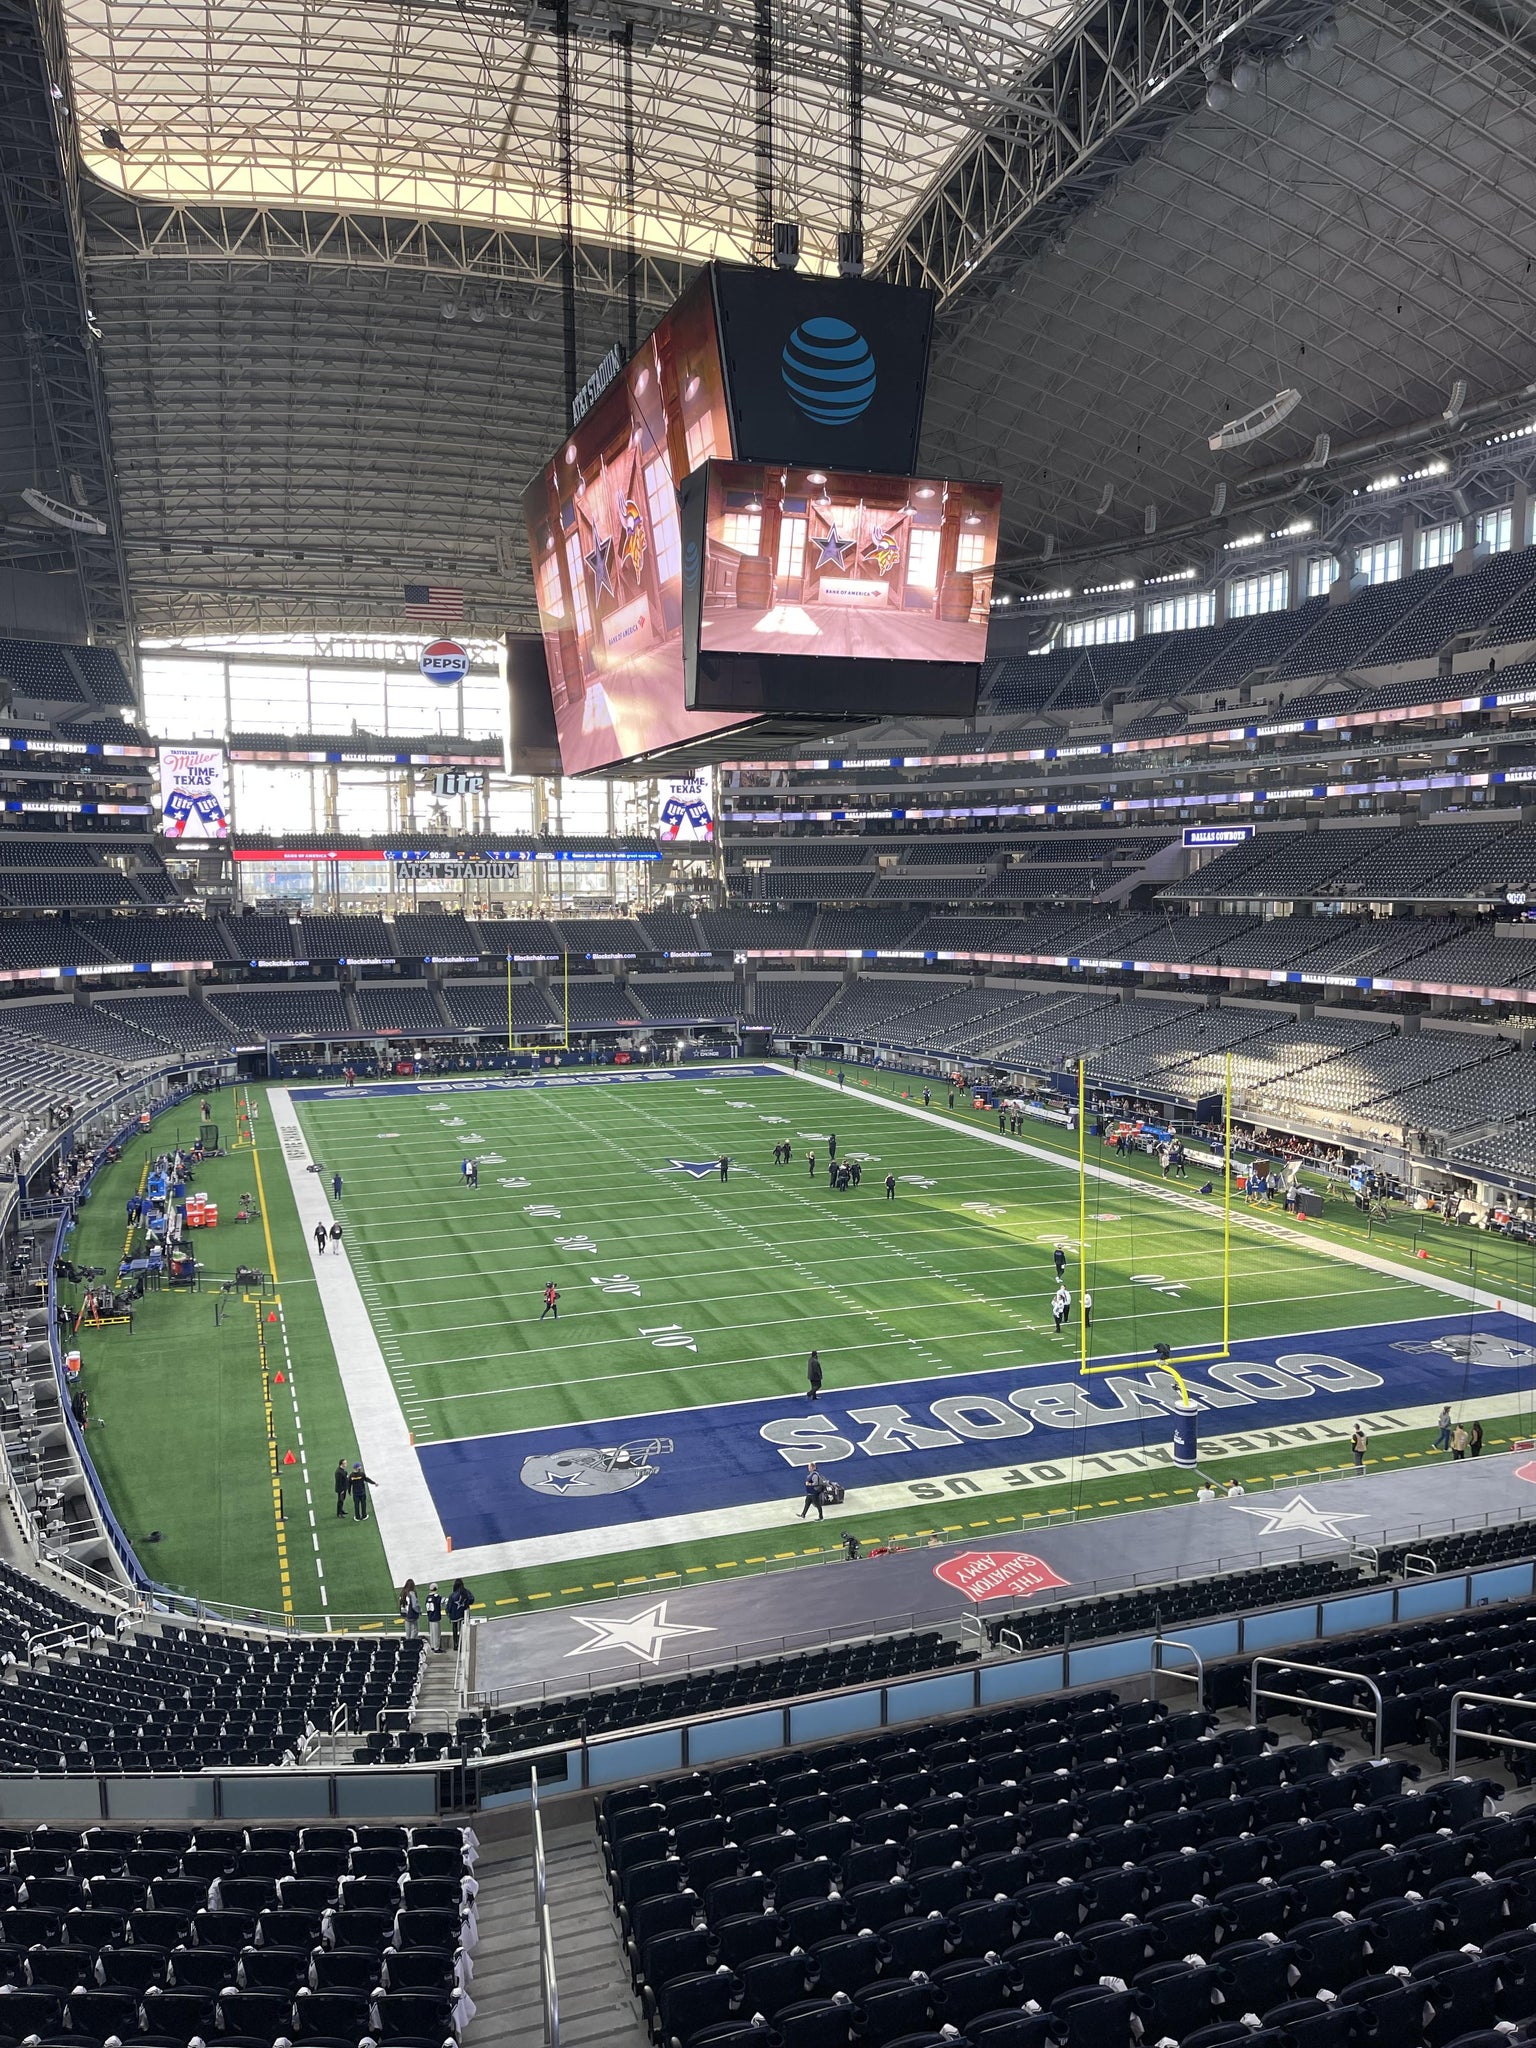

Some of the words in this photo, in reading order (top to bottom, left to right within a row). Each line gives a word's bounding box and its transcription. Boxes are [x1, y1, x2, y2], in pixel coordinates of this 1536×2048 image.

[587, 343, 620, 406] STADIUM
[423, 657, 466, 669] PEPSI
[1496, 692, 1524, 706] DALLAS
[1257, 726, 1278, 736] DALLAS
[1278, 723, 1304, 733] COWBOYS
[1489, 734, 1514, 742] MICHAEL
[27, 741, 54, 752] DALLAS
[54, 742, 87, 753] COWBOYS
[1057, 747, 1076, 757] DALLAS
[1077, 745, 1101, 755] COWBOYS
[1369, 747, 1393, 755] CHARLES
[1393, 745, 1412, 753] HALEY
[163, 752, 220, 771] Miller
[842, 760, 864, 768] DALLAS
[865, 759, 891, 767] COWBOYS
[187, 767, 219, 778] TIME,
[1505, 771, 1532, 782] DALLAS
[173, 775, 211, 785] TEXAS
[434, 773, 484, 799] Lite
[682, 777, 708, 787] TIME,
[670, 785, 702, 793] TEXAS
[1266, 791, 1287, 800] DALLAS
[1287, 789, 1313, 798] COWBOYS
[22, 803, 49, 812] DALLAS
[49, 804, 81, 813] COWBOYS
[171, 796, 193, 810] Lite
[197, 798, 218, 813] Lite
[667, 803, 686, 816] Lite
[1057, 804, 1077, 812] DALLAS
[1077, 803, 1101, 811] COWBOYS
[689, 804, 707, 818] Lite
[1191, 832, 1215, 842] DALLAS
[1216, 831, 1246, 840] COWBOYS
[402, 851, 408, 859] 0
[430, 851, 450, 859] 90:00
[505, 851, 510, 859] 0
[398, 863, 440, 879] AT&T
[444, 863, 519, 879] STADIUM
[76, 966, 102, 975] DALLAS
[103, 965, 134, 974] COWBOYS
[1080, 959, 1100, 967] DALLAS
[1100, 960, 1121, 968] COWBOYS
[1301, 974, 1326, 984] DALLAS
[1326, 976, 1357, 986] COWBOYS
[417, 1072, 676, 1092] COWBOYS
[1128, 1181, 1211, 1208] CHANGE
[1207, 1209, 1306, 1240] INSPIRE
[554, 1235, 597, 1250] 30
[590, 1274, 640, 1293] 20
[1129, 1274, 1192, 1293] 10
[638, 1324, 694, 1347] 10
[759, 1353, 1385, 1467] COWBOYS
[1370, 1415, 1410, 1433] IT
[1202, 1424, 1338, 1457] TAKES
[1080, 1445, 1177, 1473] ALL
[1001, 1464, 1067, 1484] OF
[907, 1476, 984, 1502] US
[956, 1553, 997, 1584] ARMY
[966, 1554, 1037, 1597] SALVATION
[1008, 1571, 1044, 1593] THE
